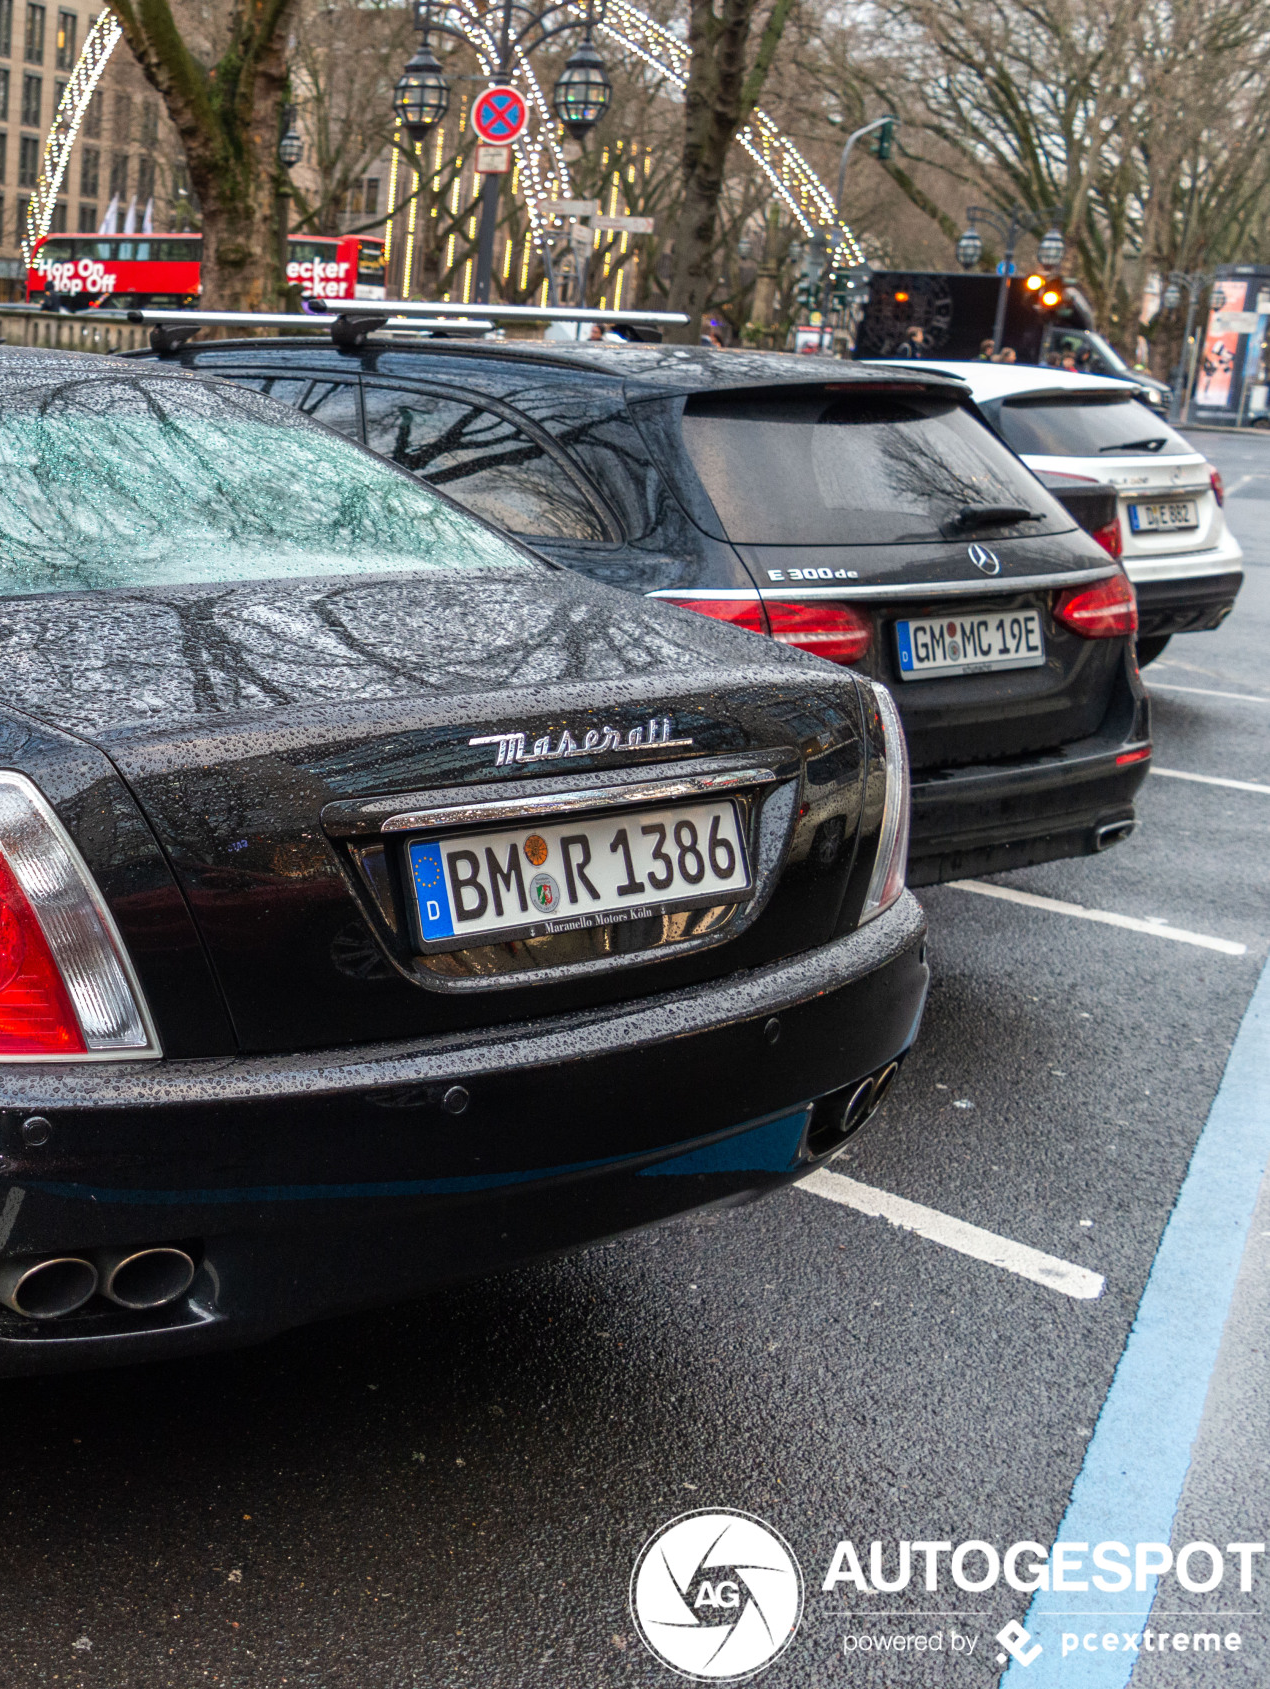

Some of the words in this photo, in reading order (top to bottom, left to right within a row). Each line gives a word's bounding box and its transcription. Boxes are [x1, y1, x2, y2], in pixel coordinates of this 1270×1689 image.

[38, 259, 75, 281] Hop
[77, 258, 104, 277] On
[86, 273, 117, 293] Off
[288, 278, 348, 298] cker
[767, 569, 785, 581] E
[787, 567, 859, 581] 300de
[913, 626, 947, 663] GM
[960, 620, 992, 658] MC
[996, 616, 1039, 655] 19E
[902, 651, 909, 662] D
[468, 718, 693, 766] Maserati
[446, 843, 528, 922] BM
[560, 834, 601, 903] R
[610, 815, 736, 897] 1386
[427, 900, 440, 921] D
[545, 917, 593, 934] Maranello
[596, 913, 628, 926] Motors
[630, 907, 652, 920] Köln
